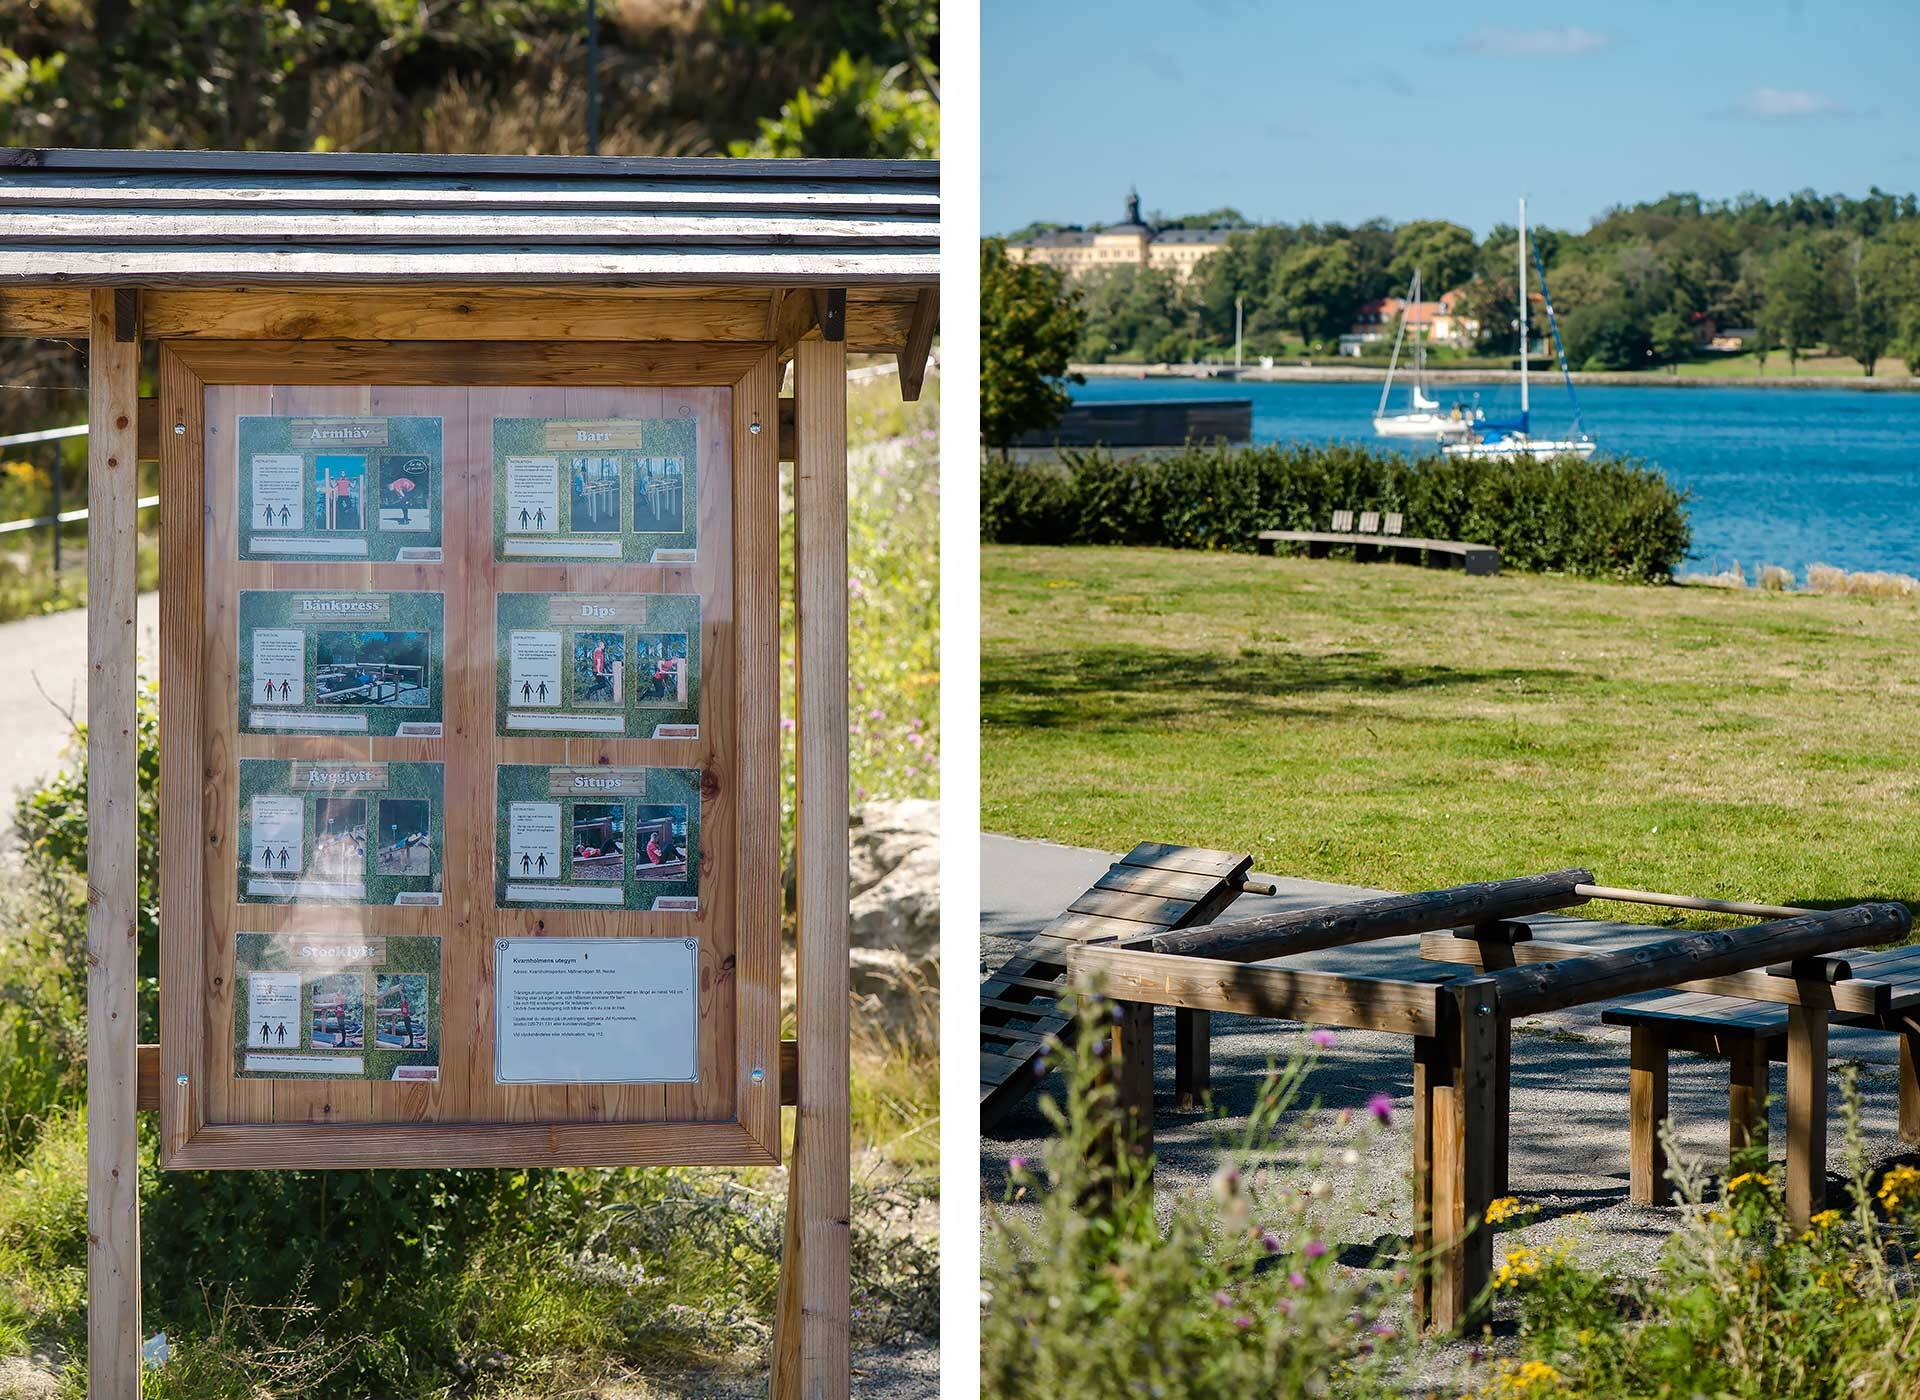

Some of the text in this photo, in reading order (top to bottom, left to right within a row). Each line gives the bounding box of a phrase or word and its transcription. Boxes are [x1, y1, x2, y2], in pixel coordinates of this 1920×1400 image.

[310, 427, 370, 439] Armhäv
[576, 430, 612, 442] Barr
[302, 599, 381, 613] Bänkpress
[581, 604, 616, 617] Dips
[309, 769, 374, 784] Rygglyft
[574, 776, 622, 788] Situps
